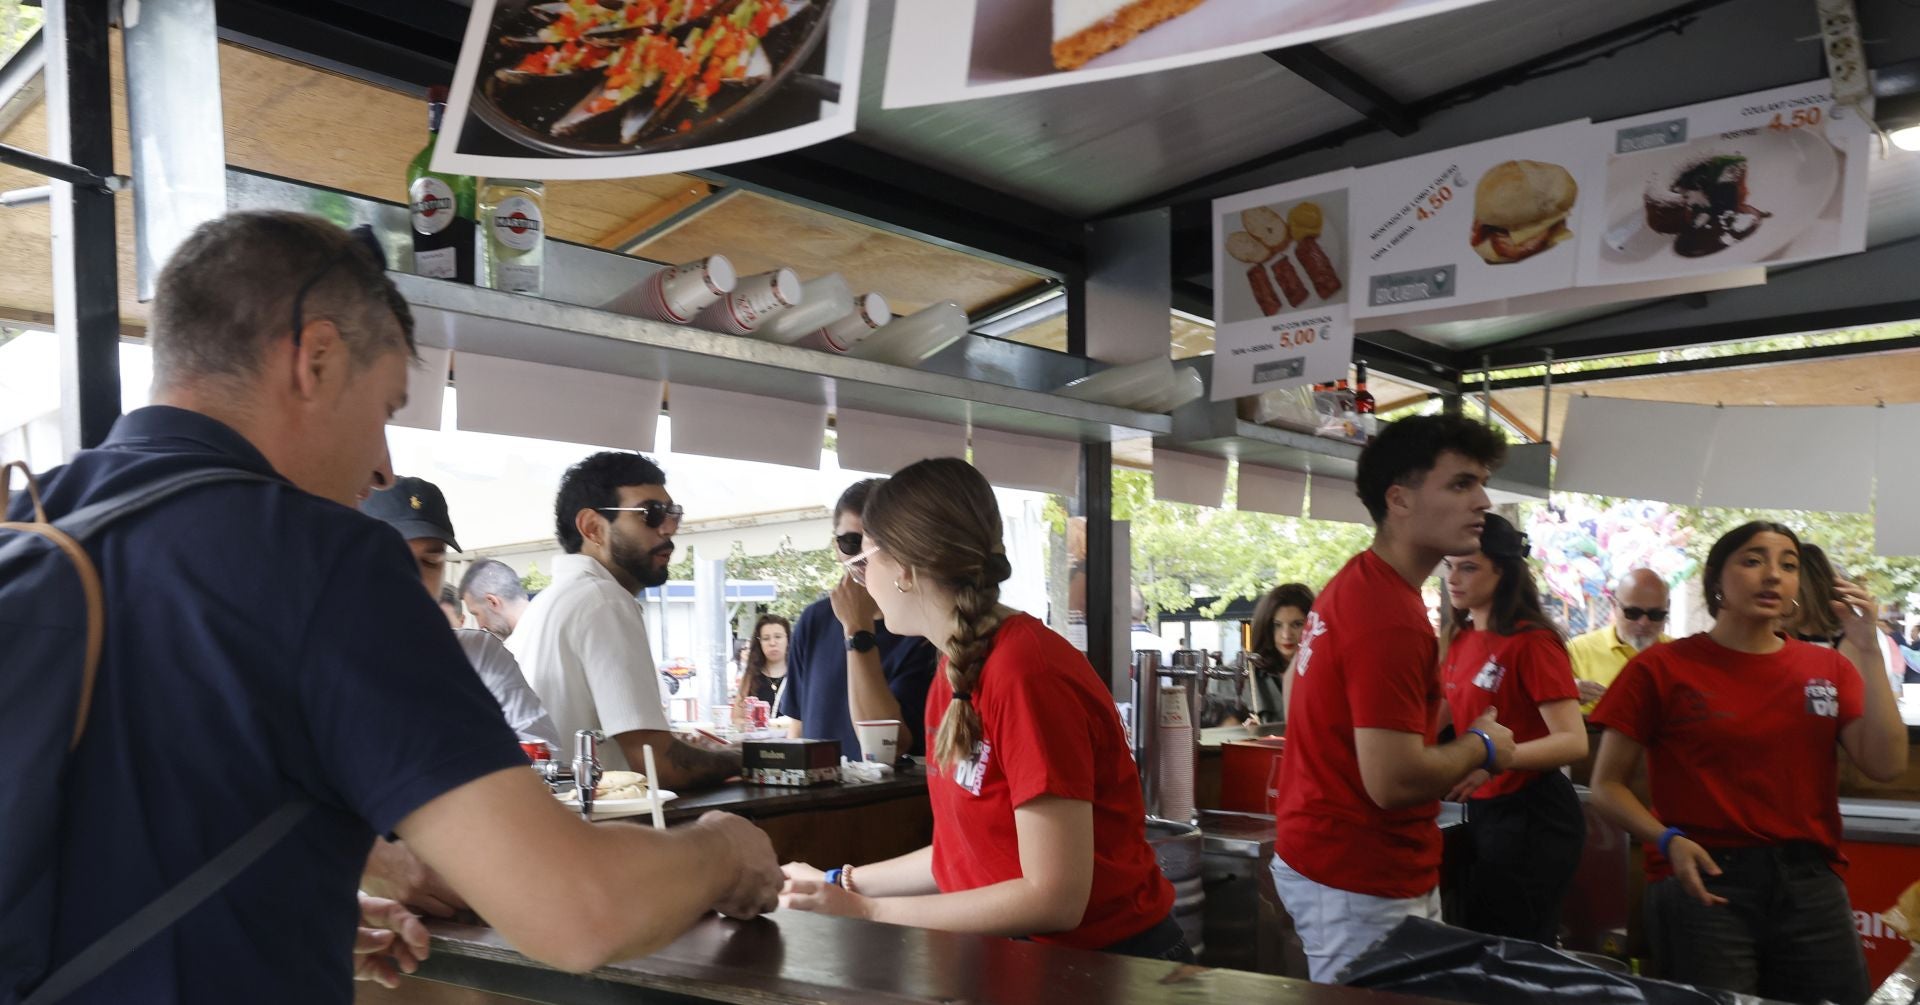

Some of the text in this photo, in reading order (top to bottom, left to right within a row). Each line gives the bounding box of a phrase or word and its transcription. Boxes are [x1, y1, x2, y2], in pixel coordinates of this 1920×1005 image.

[1416, 186, 1453, 221] 4,50
[495, 216, 540, 231] MARTINI
[1280, 328, 1315, 351] 5,00
